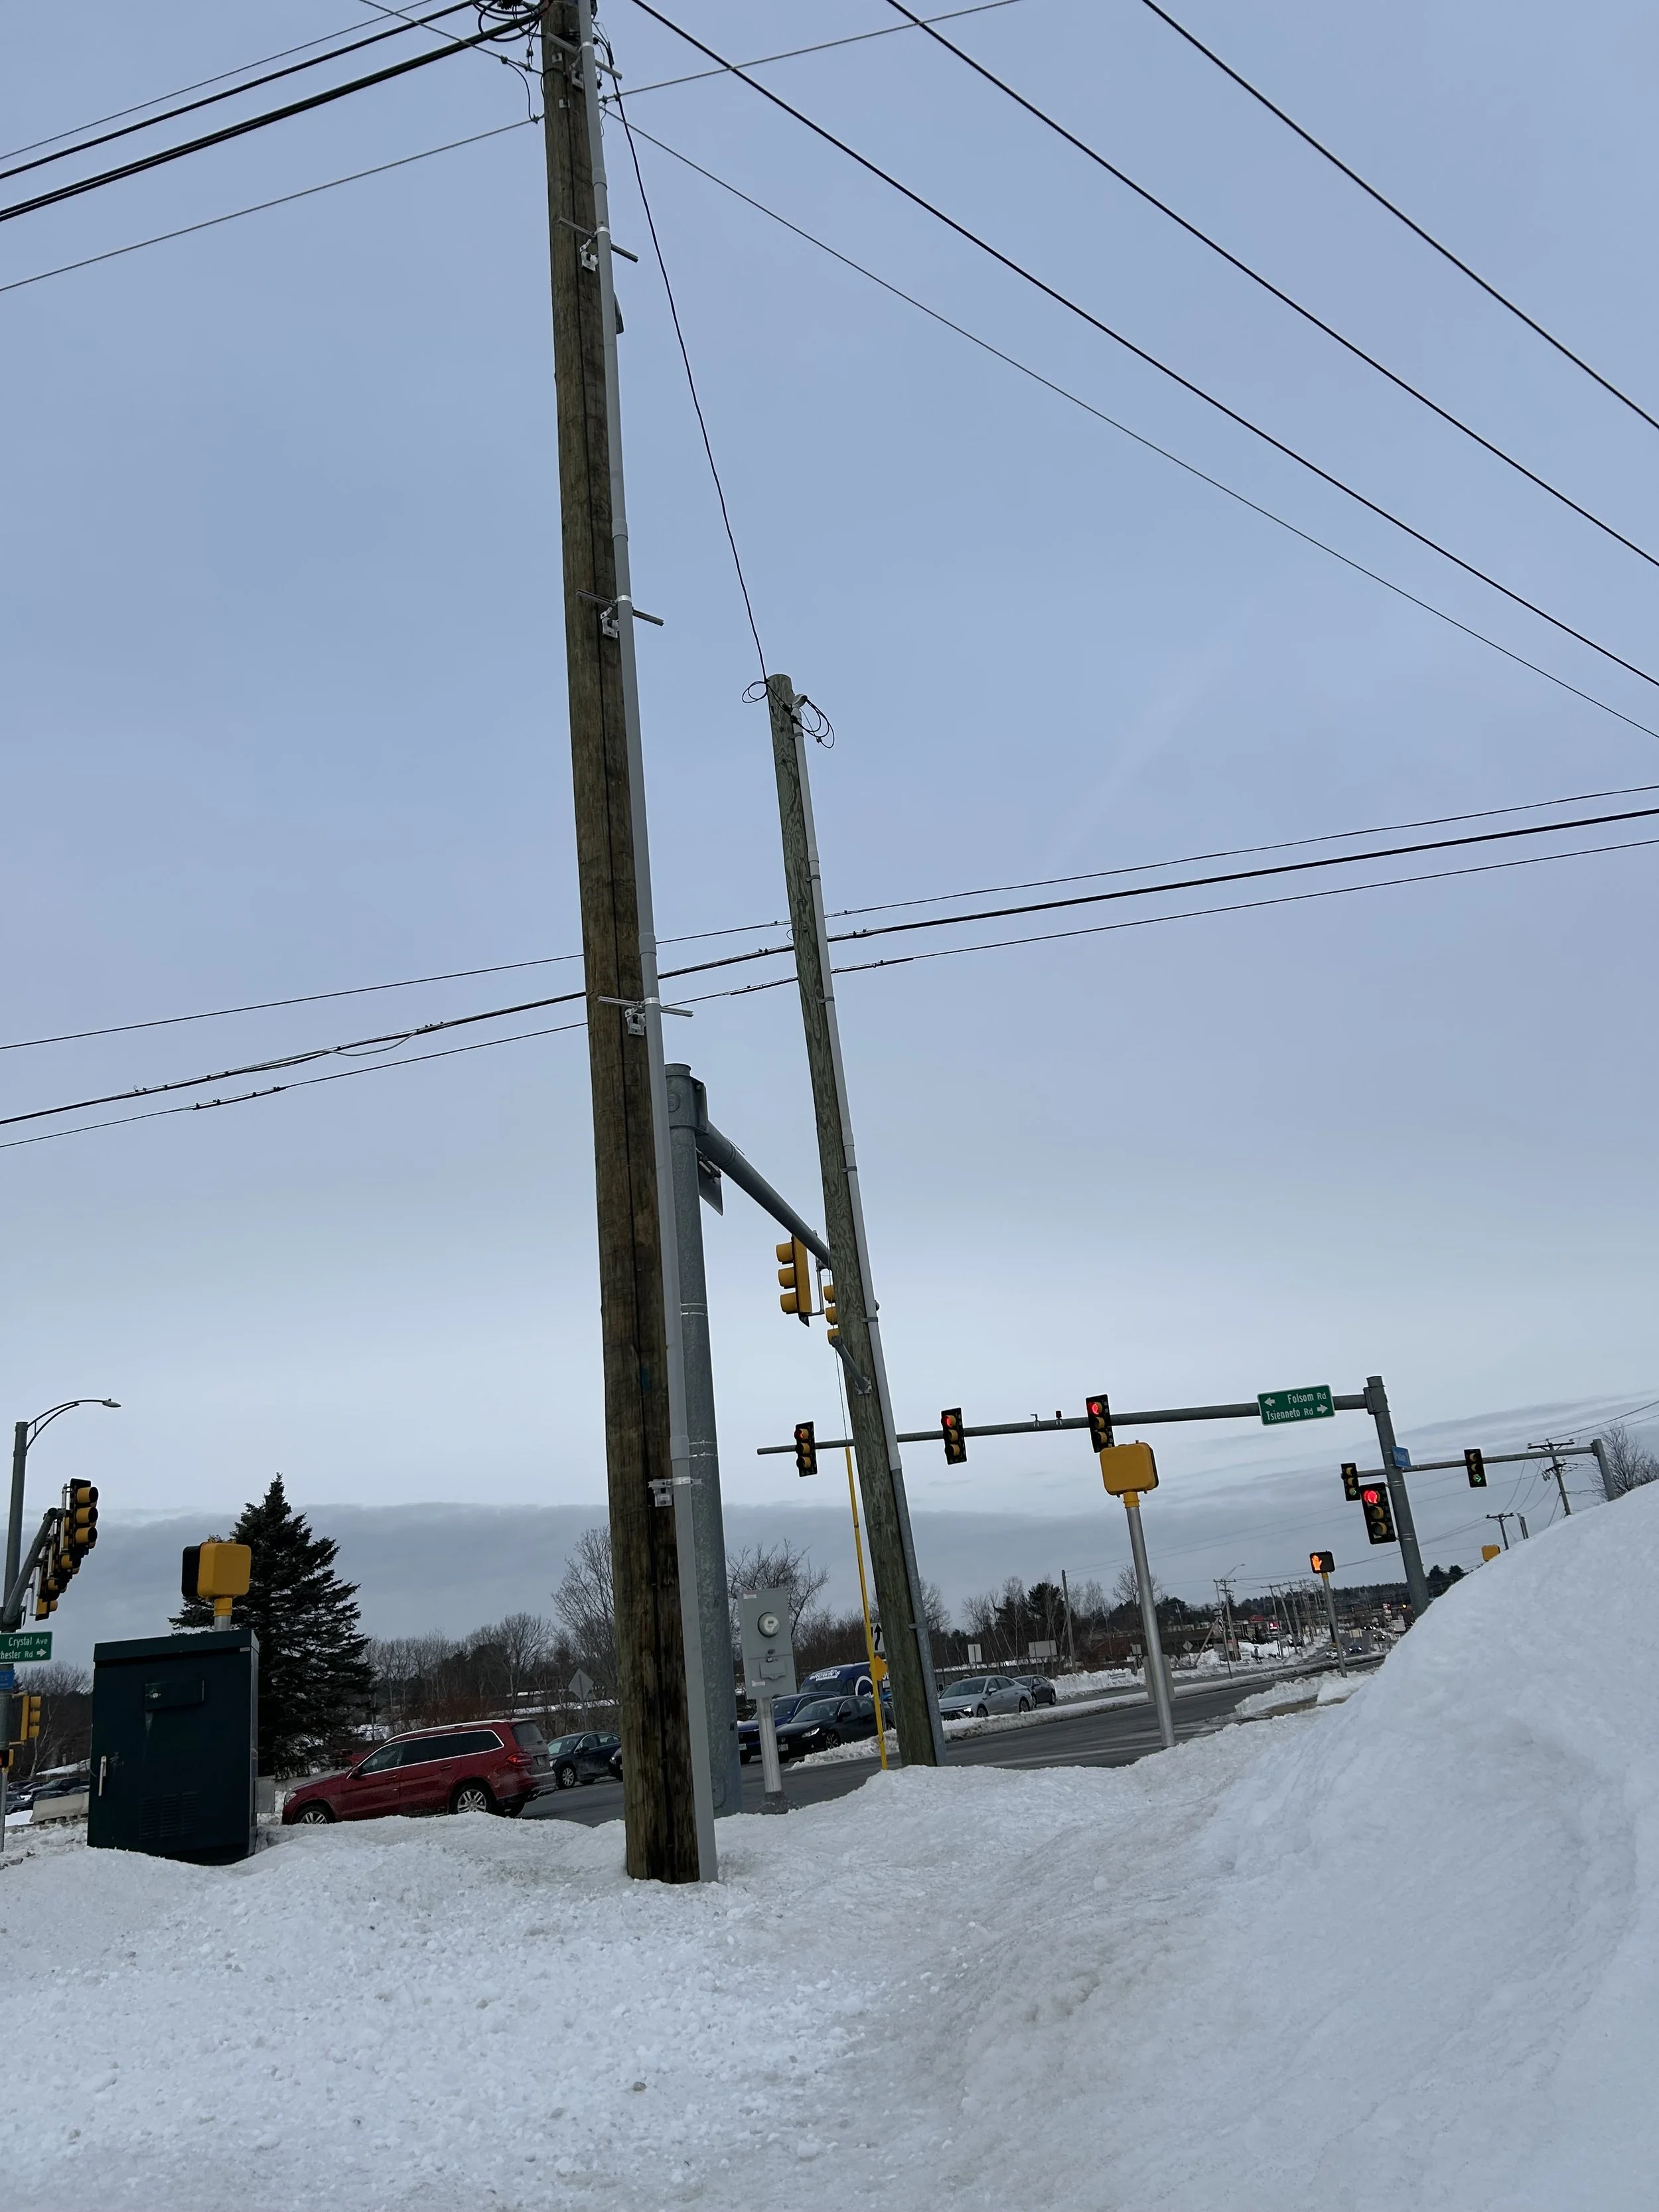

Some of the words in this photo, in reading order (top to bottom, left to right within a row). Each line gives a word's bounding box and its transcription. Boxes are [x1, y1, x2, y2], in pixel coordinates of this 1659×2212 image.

[1287, 1394, 1314, 1404] Folsom
[1265, 1408, 1301, 1421] Tsienneto
[1304, 1408, 1314, 1416] Rd
[9, 1637, 33, 1648] Crystal
